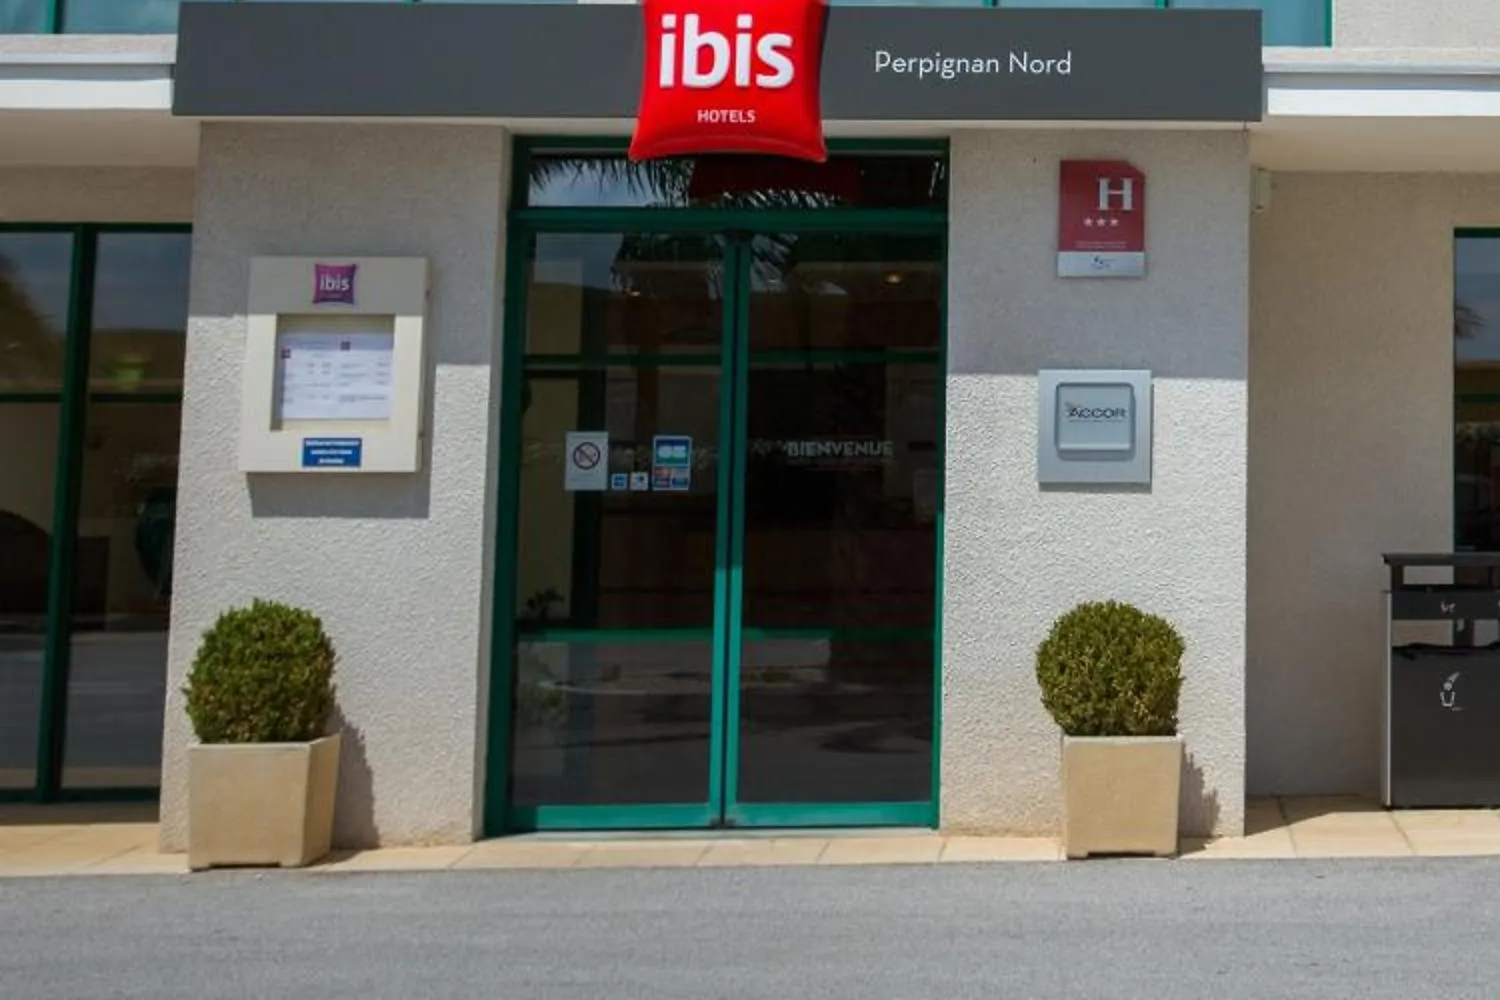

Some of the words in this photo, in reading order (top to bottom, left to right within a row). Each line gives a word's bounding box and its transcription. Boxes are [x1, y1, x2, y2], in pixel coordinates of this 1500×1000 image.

[659, 13, 795, 88] ibis
[875, 51, 999, 79] Perpignan
[1009, 52, 1072, 75] Nord
[697, 109, 757, 124] HOTELS
[1097, 177, 1135, 211] H
[320, 273, 350, 291] ibis
[787, 440, 894, 457] BIENVENUE
